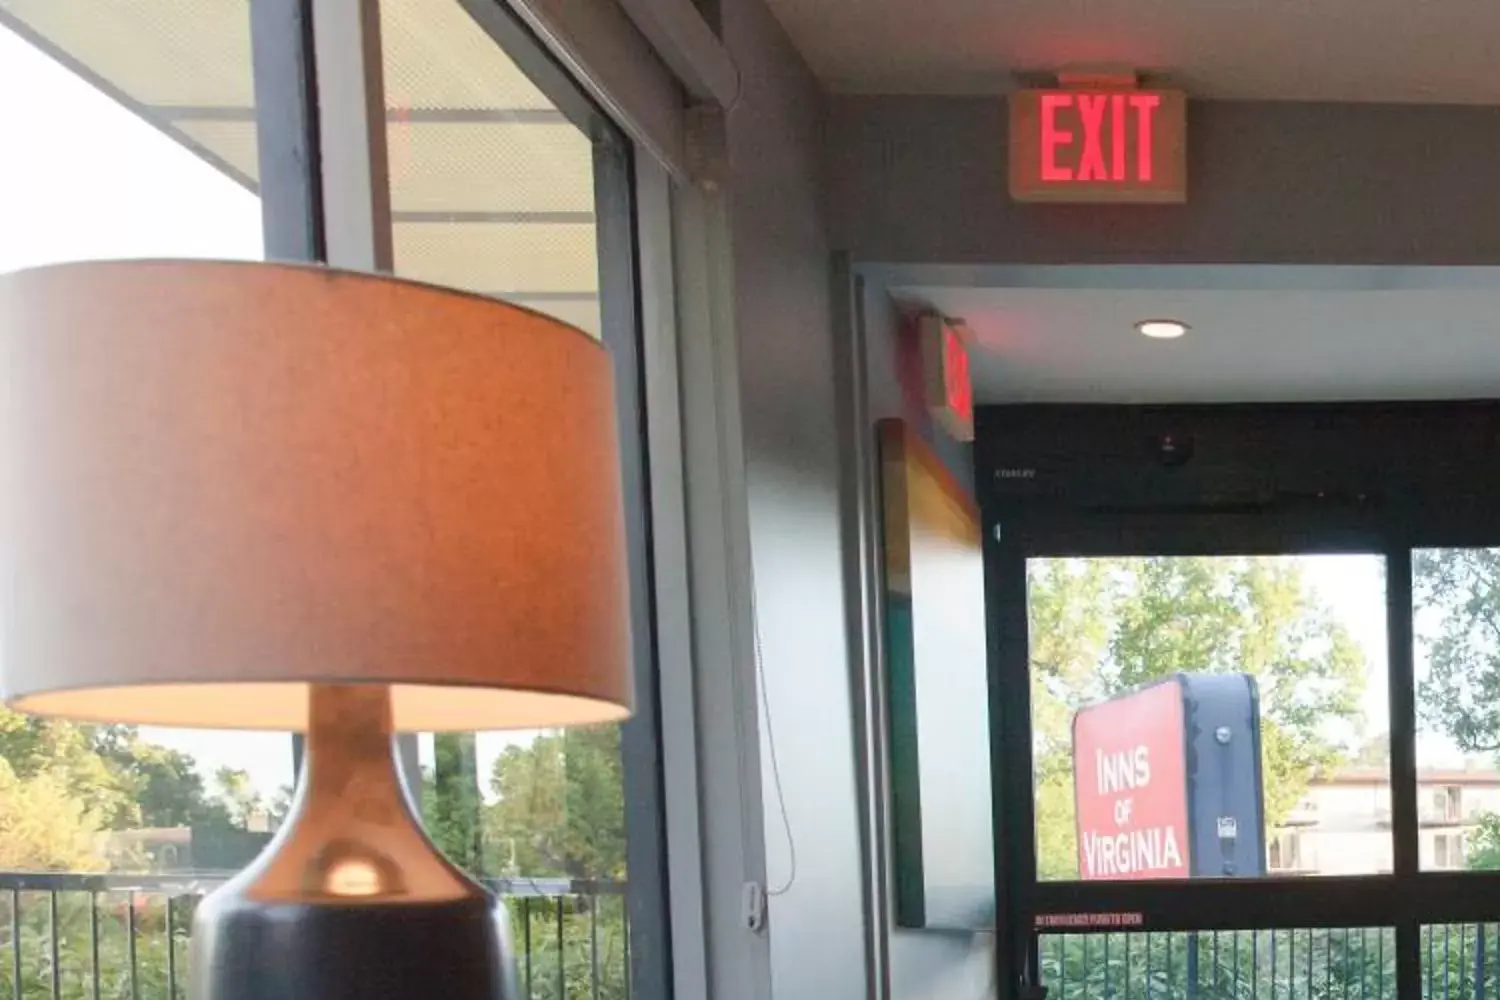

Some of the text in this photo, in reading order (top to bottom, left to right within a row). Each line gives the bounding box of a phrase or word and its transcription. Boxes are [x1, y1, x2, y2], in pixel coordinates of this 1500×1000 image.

[1041, 94, 1160, 181] EXIT
[1096, 745, 1151, 795] INNS
[1114, 798, 1133, 827] OF
[1083, 825, 1183, 876] VIRGINIA
